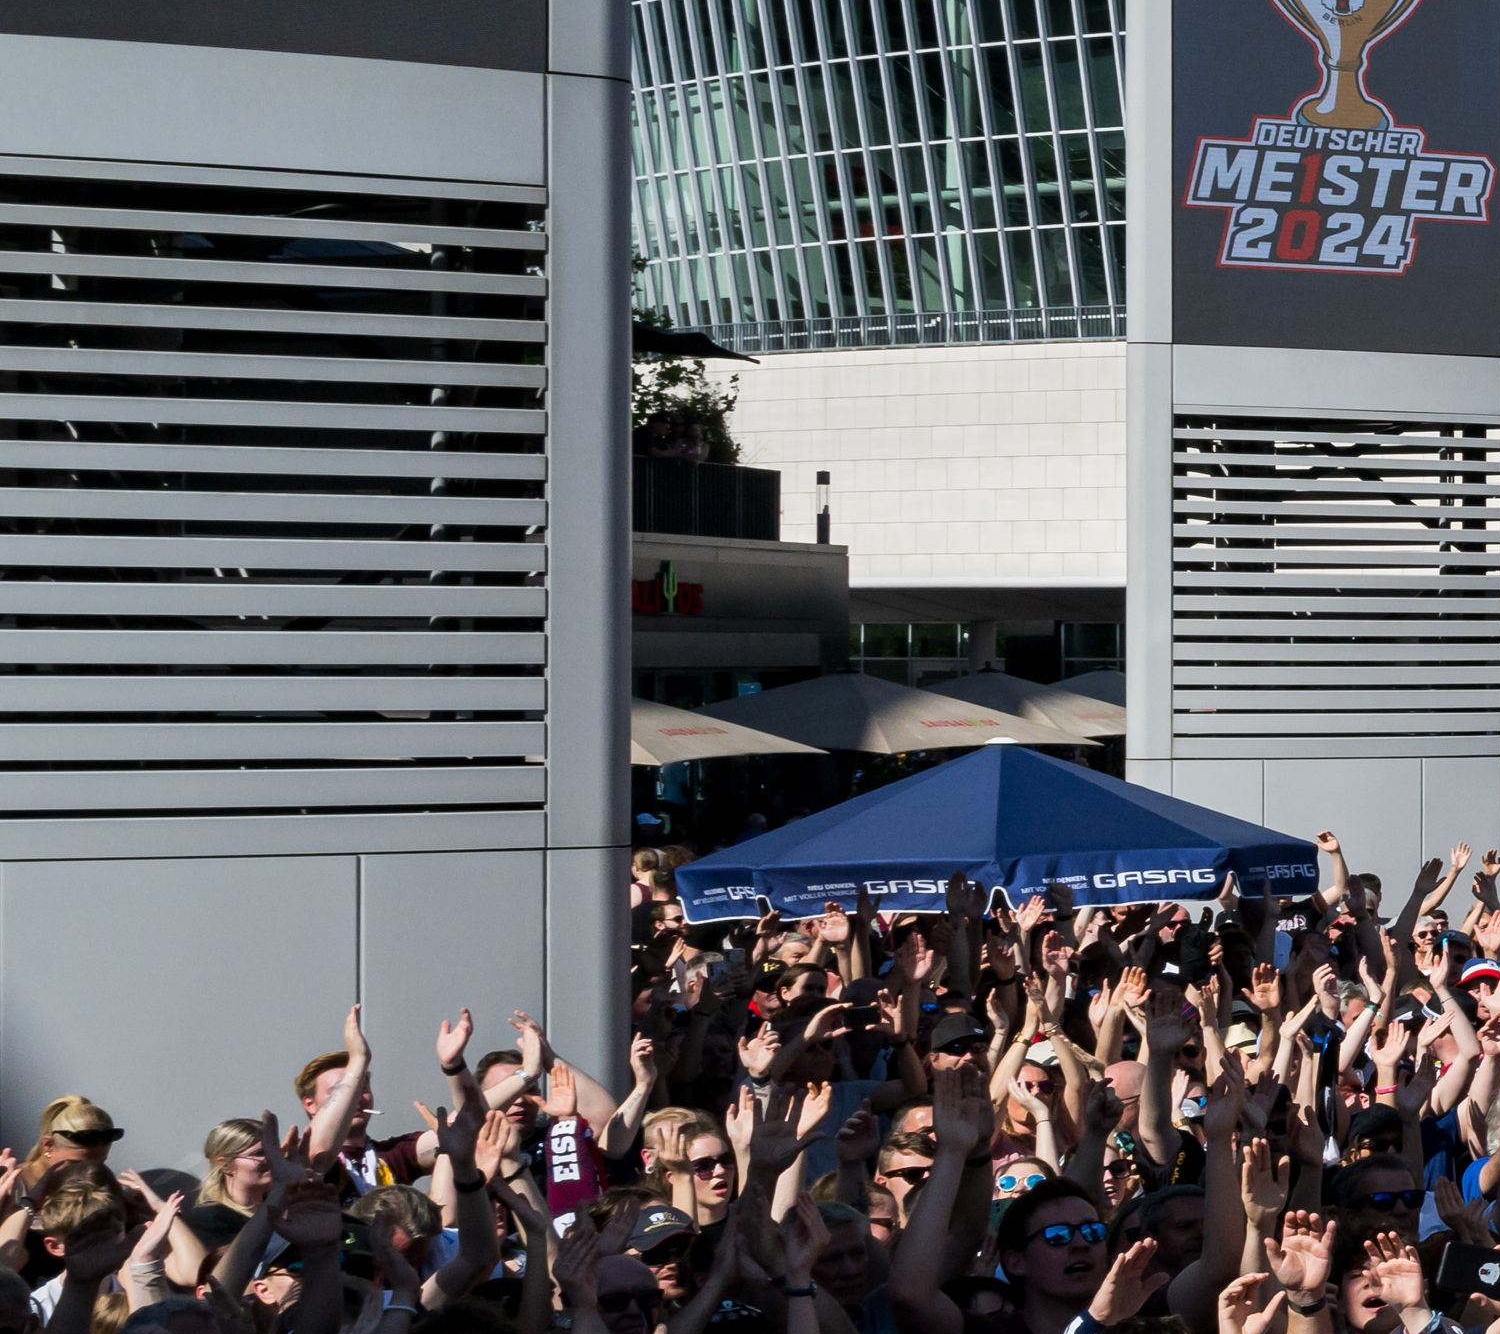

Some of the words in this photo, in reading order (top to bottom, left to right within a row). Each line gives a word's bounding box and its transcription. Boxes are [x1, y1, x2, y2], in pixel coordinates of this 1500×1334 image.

[1321, 12, 1364, 29] BERLIN
[1254, 125, 1422, 157] DEUTSCHER
[1231, 207, 1409, 266] 2024
[1093, 868, 1217, 888] GASAG
[1266, 863, 1317, 880] GASAG
